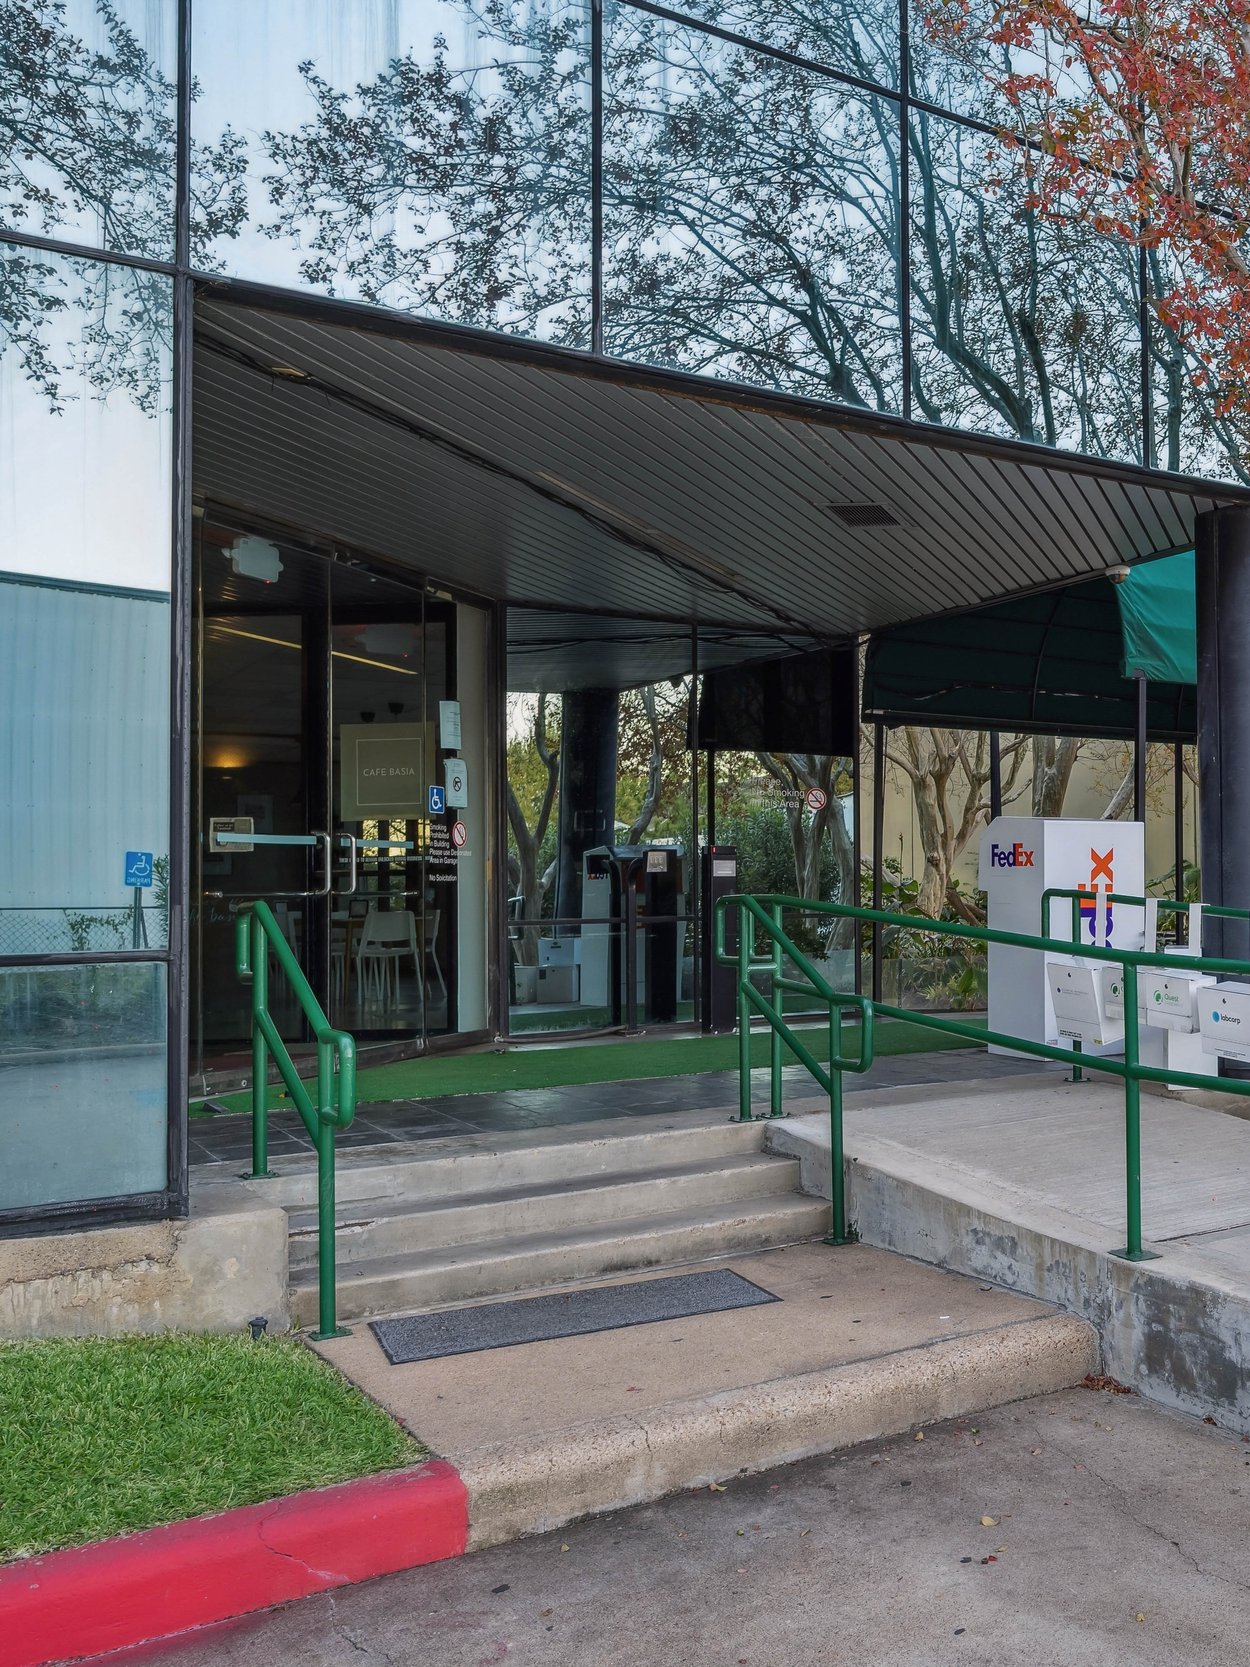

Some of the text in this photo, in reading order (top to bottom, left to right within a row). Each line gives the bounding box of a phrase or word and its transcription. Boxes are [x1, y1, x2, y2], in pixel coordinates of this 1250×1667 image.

[363, 767, 415, 777] CAFE BASIA
[767, 788, 805, 799] Smoking
[779, 800, 800, 808] Area
[434, 840, 450, 849] Building
[429, 856, 439, 864] Area
[990, 842, 1035, 868] FedEx
[1220, 1013, 1241, 1025] labcorp
